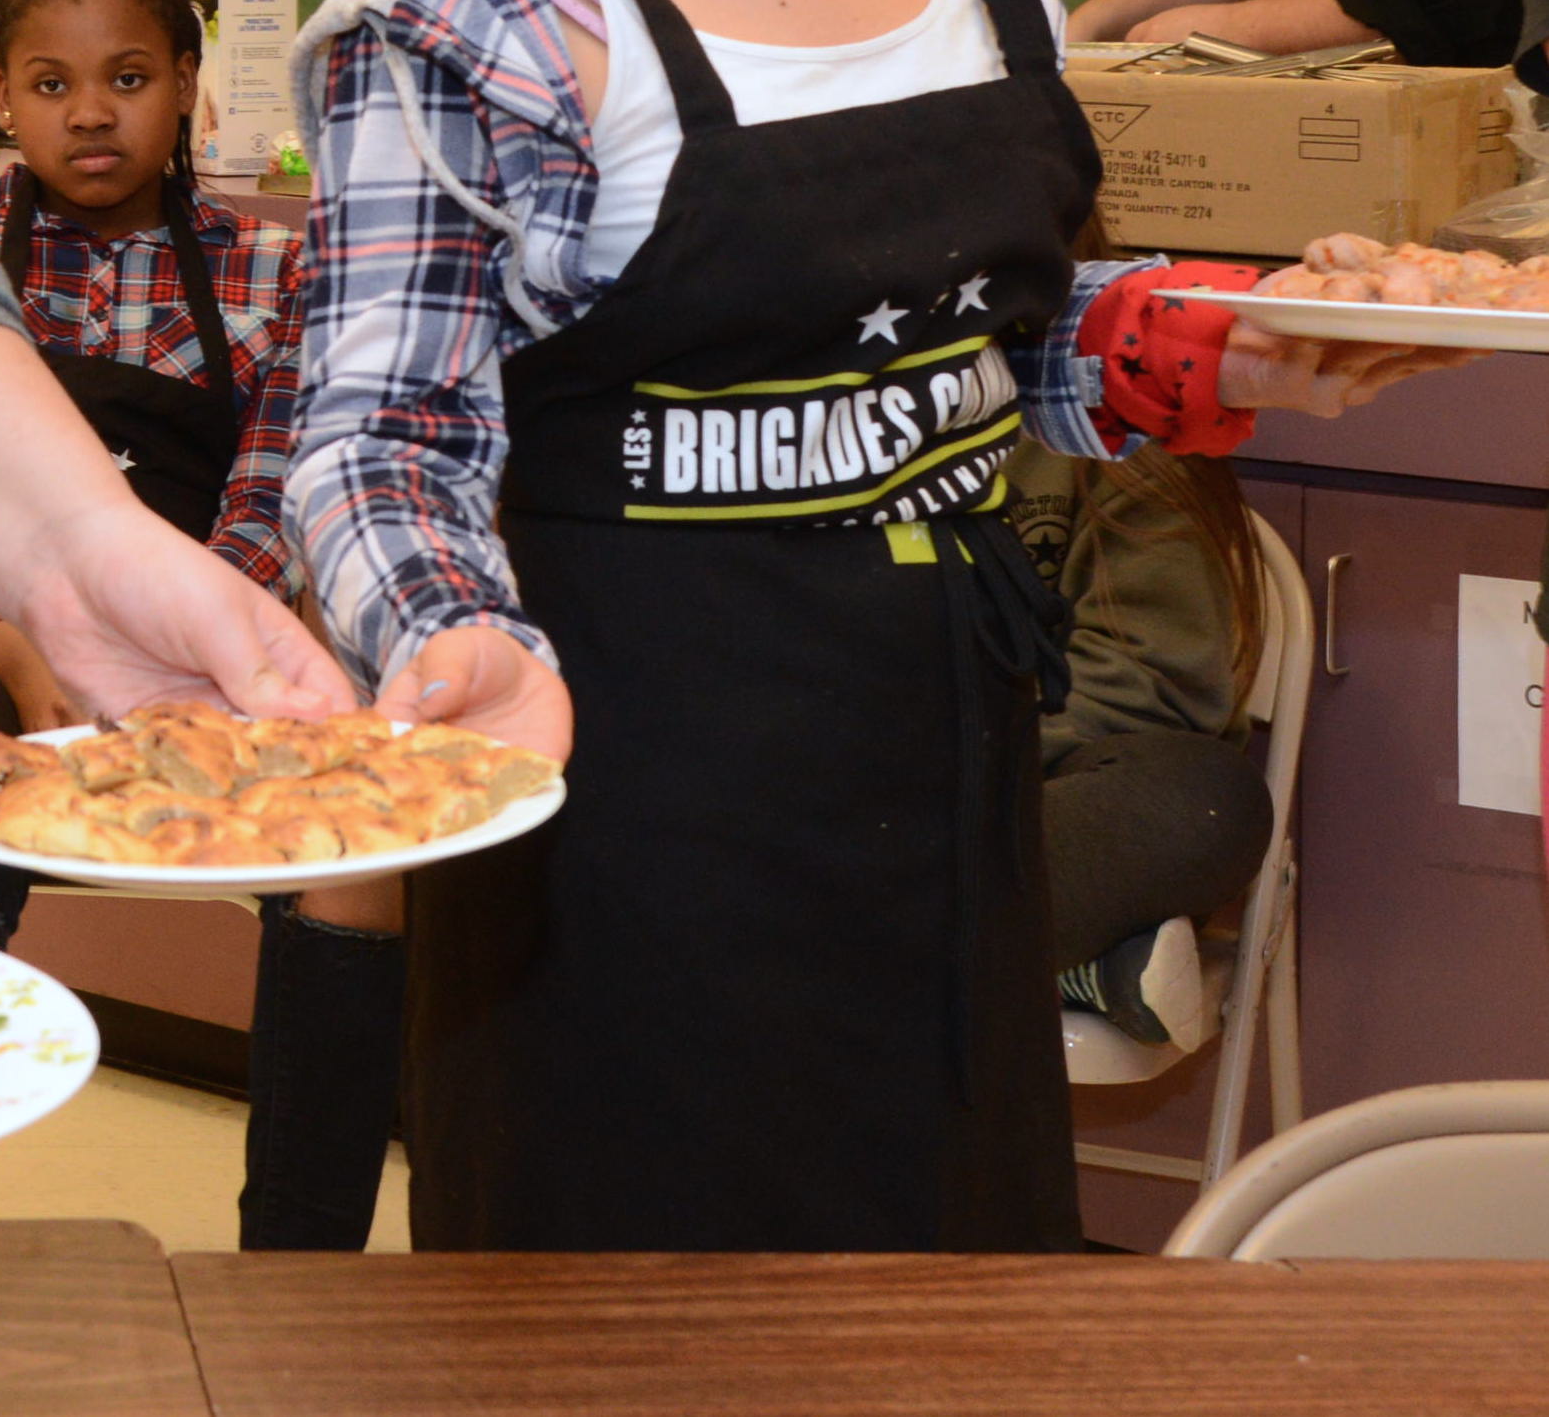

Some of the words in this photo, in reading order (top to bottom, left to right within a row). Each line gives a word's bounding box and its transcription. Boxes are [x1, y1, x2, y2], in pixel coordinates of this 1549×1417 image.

[1324, 103, 1335, 115] 4
[1092, 111, 1126, 123] CTC
[1121, 177, 1165, 187] MASTER
[1183, 205, 1213, 220] 2274
[623, 427, 652, 470] LES
[663, 385, 924, 494] BRIGADES
